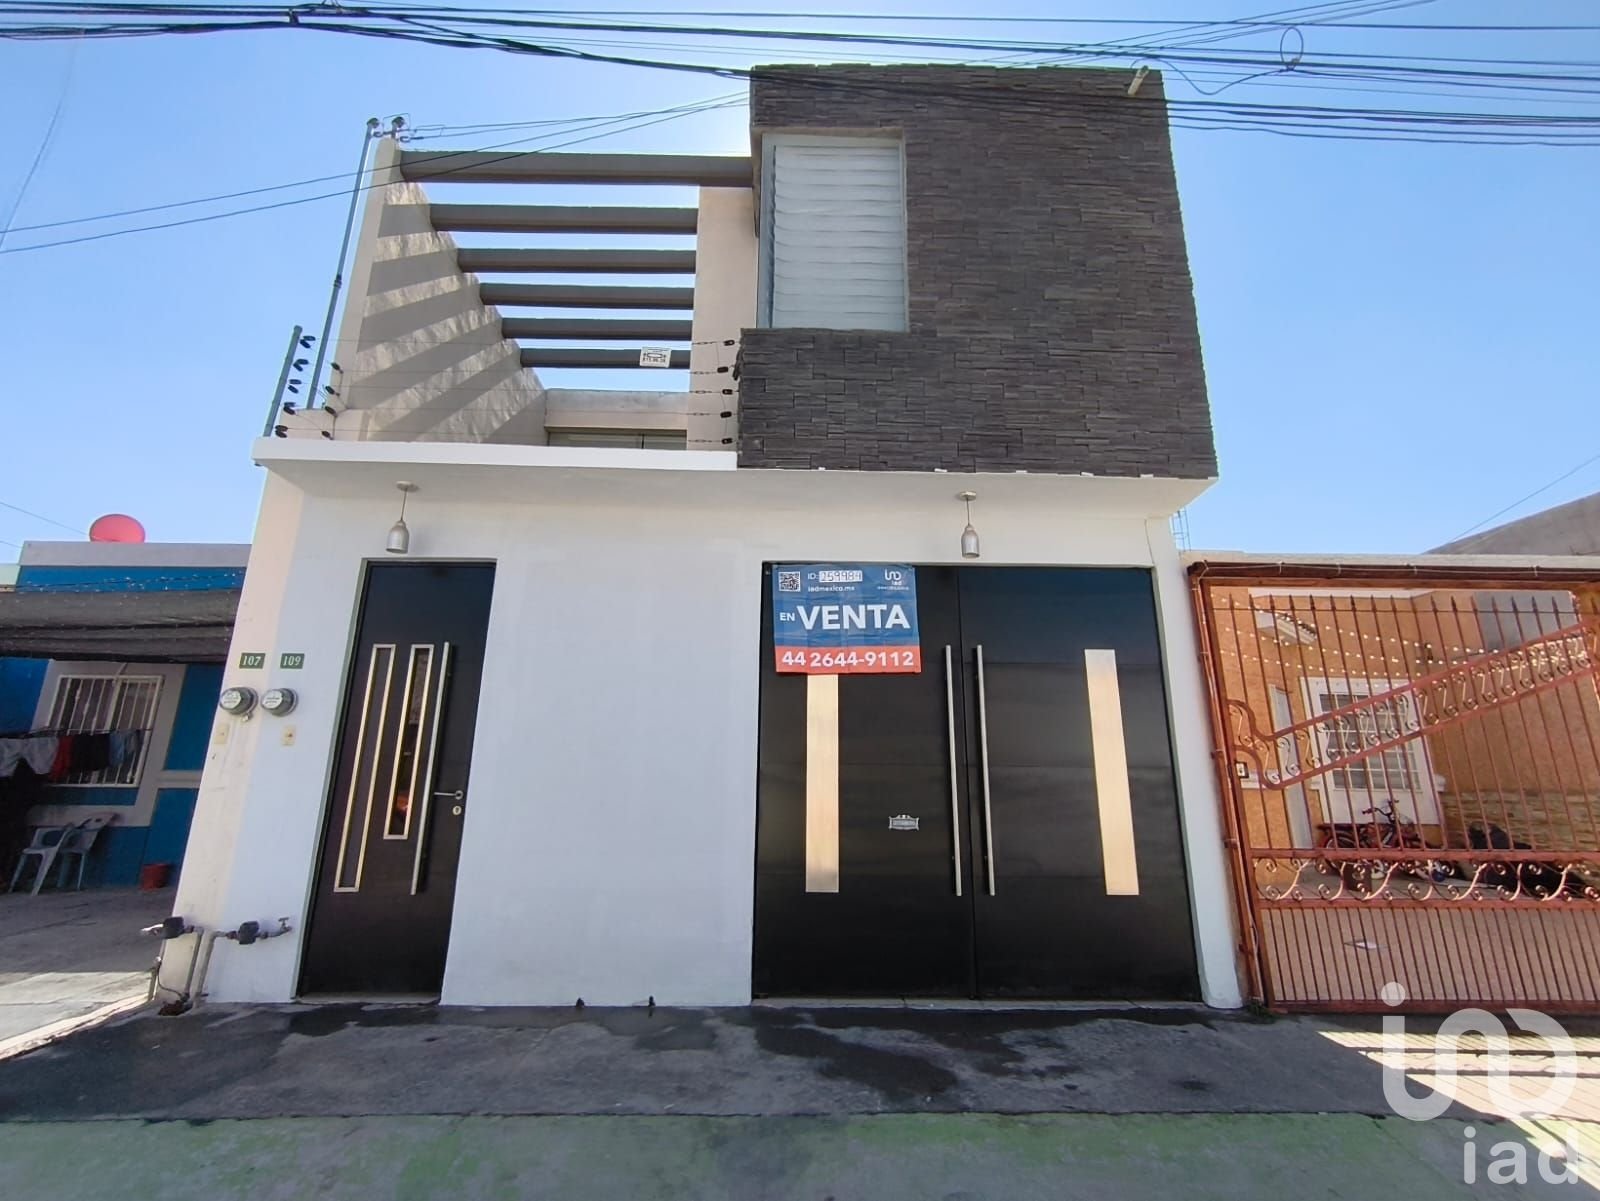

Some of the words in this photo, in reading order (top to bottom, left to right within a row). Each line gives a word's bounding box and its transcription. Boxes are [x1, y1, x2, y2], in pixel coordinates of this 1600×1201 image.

[779, 613, 795, 622] EN
[796, 604, 911, 630] VENTA
[242, 655, 262, 666] 107
[283, 655, 301, 666] 109
[782, 651, 806, 666] 44
[810, 651, 914, 667] 2644-9112
